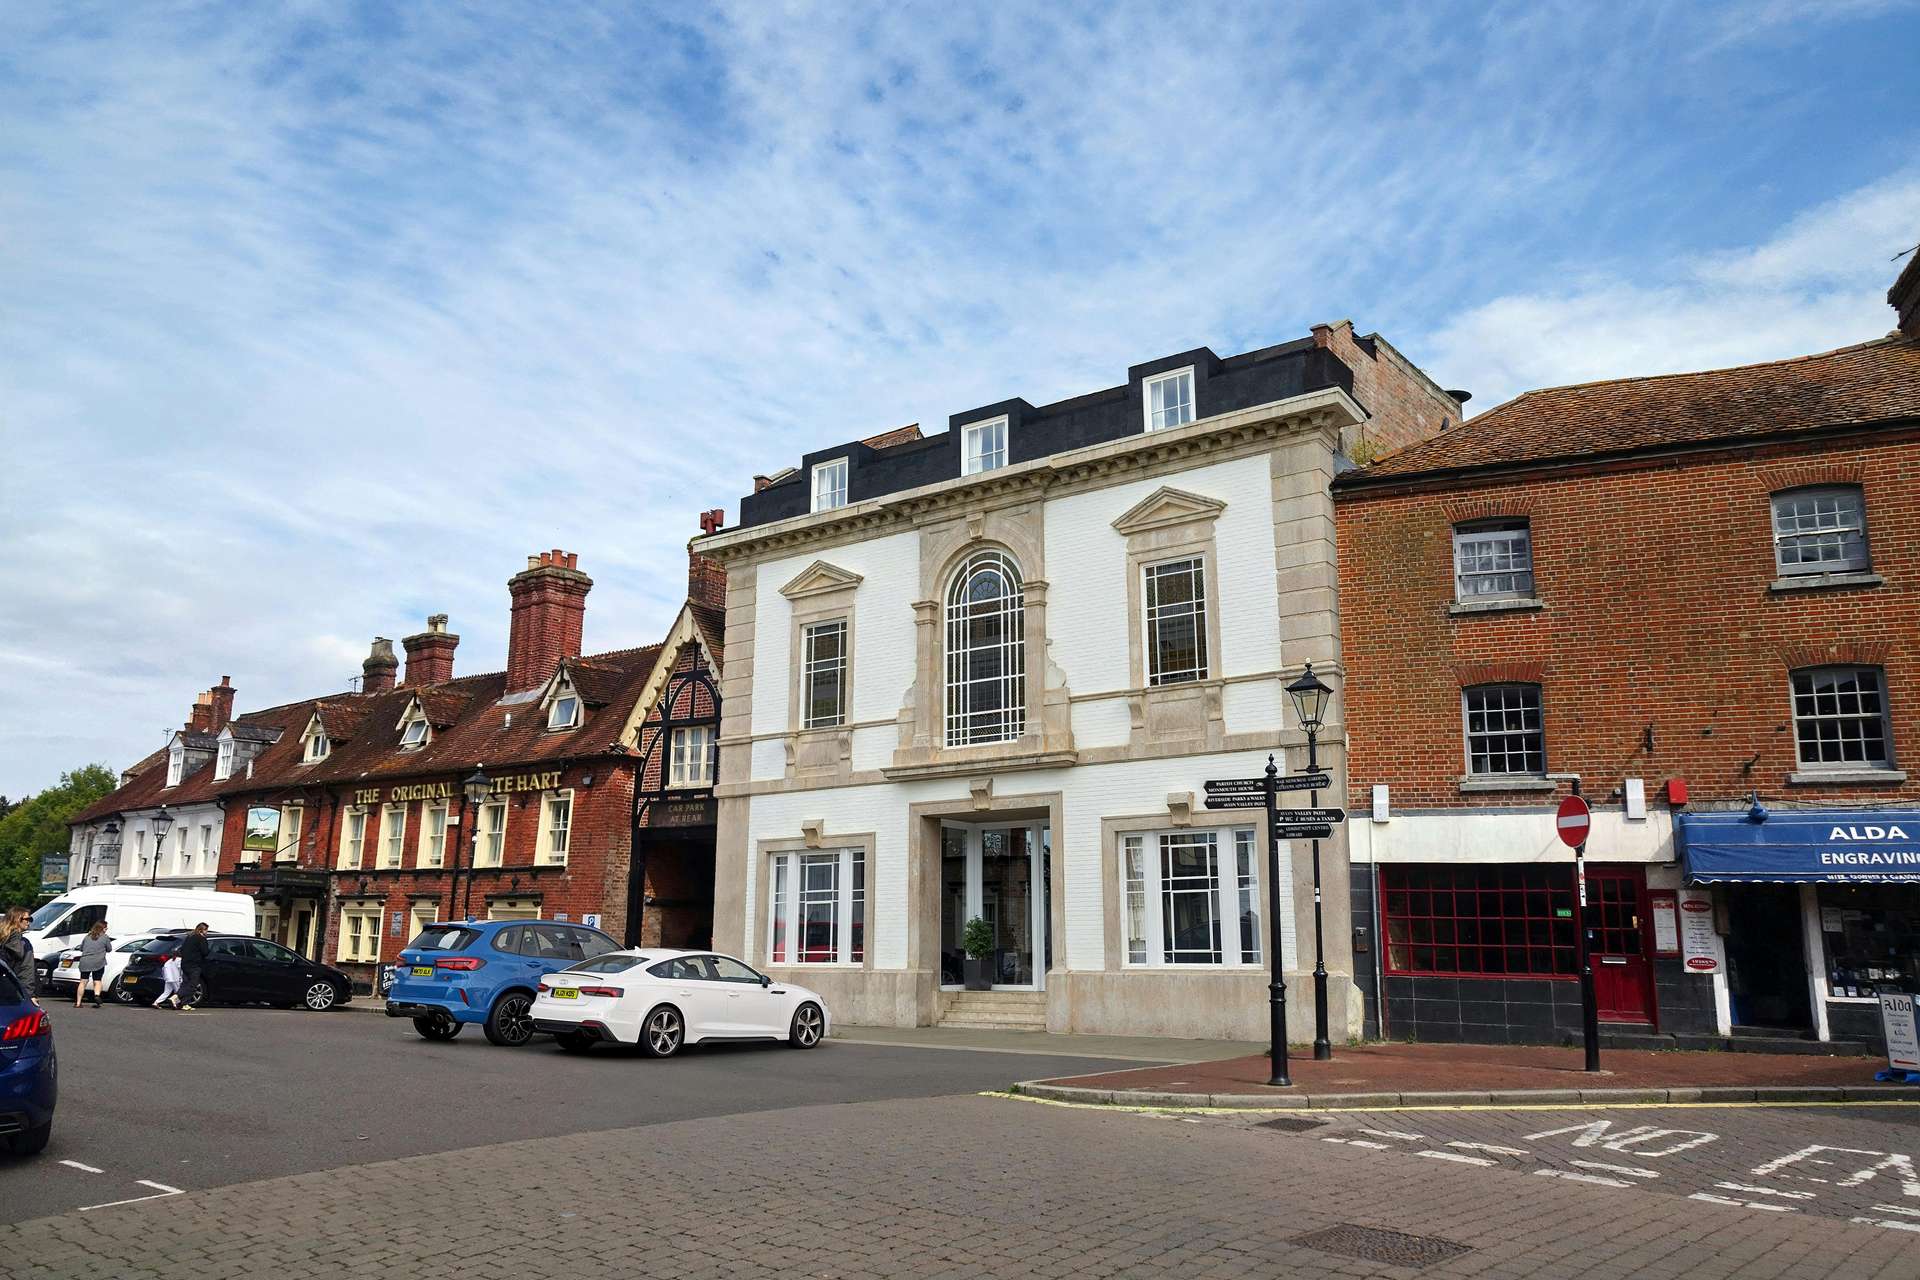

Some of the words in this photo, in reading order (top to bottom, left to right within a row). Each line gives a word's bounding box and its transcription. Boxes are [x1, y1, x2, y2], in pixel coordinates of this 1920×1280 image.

[355, 788, 380, 804] THE
[391, 783, 454, 802] ORIGINAL
[517, 771, 562, 792] HART
[668, 804, 683, 813] CAR
[685, 803, 705, 812] PARK
[670, 815, 680, 823] AT
[681, 814, 703, 823] REAR
[1829, 826, 1910, 840] ALDA
[1522, 1120, 1720, 1157] NO
